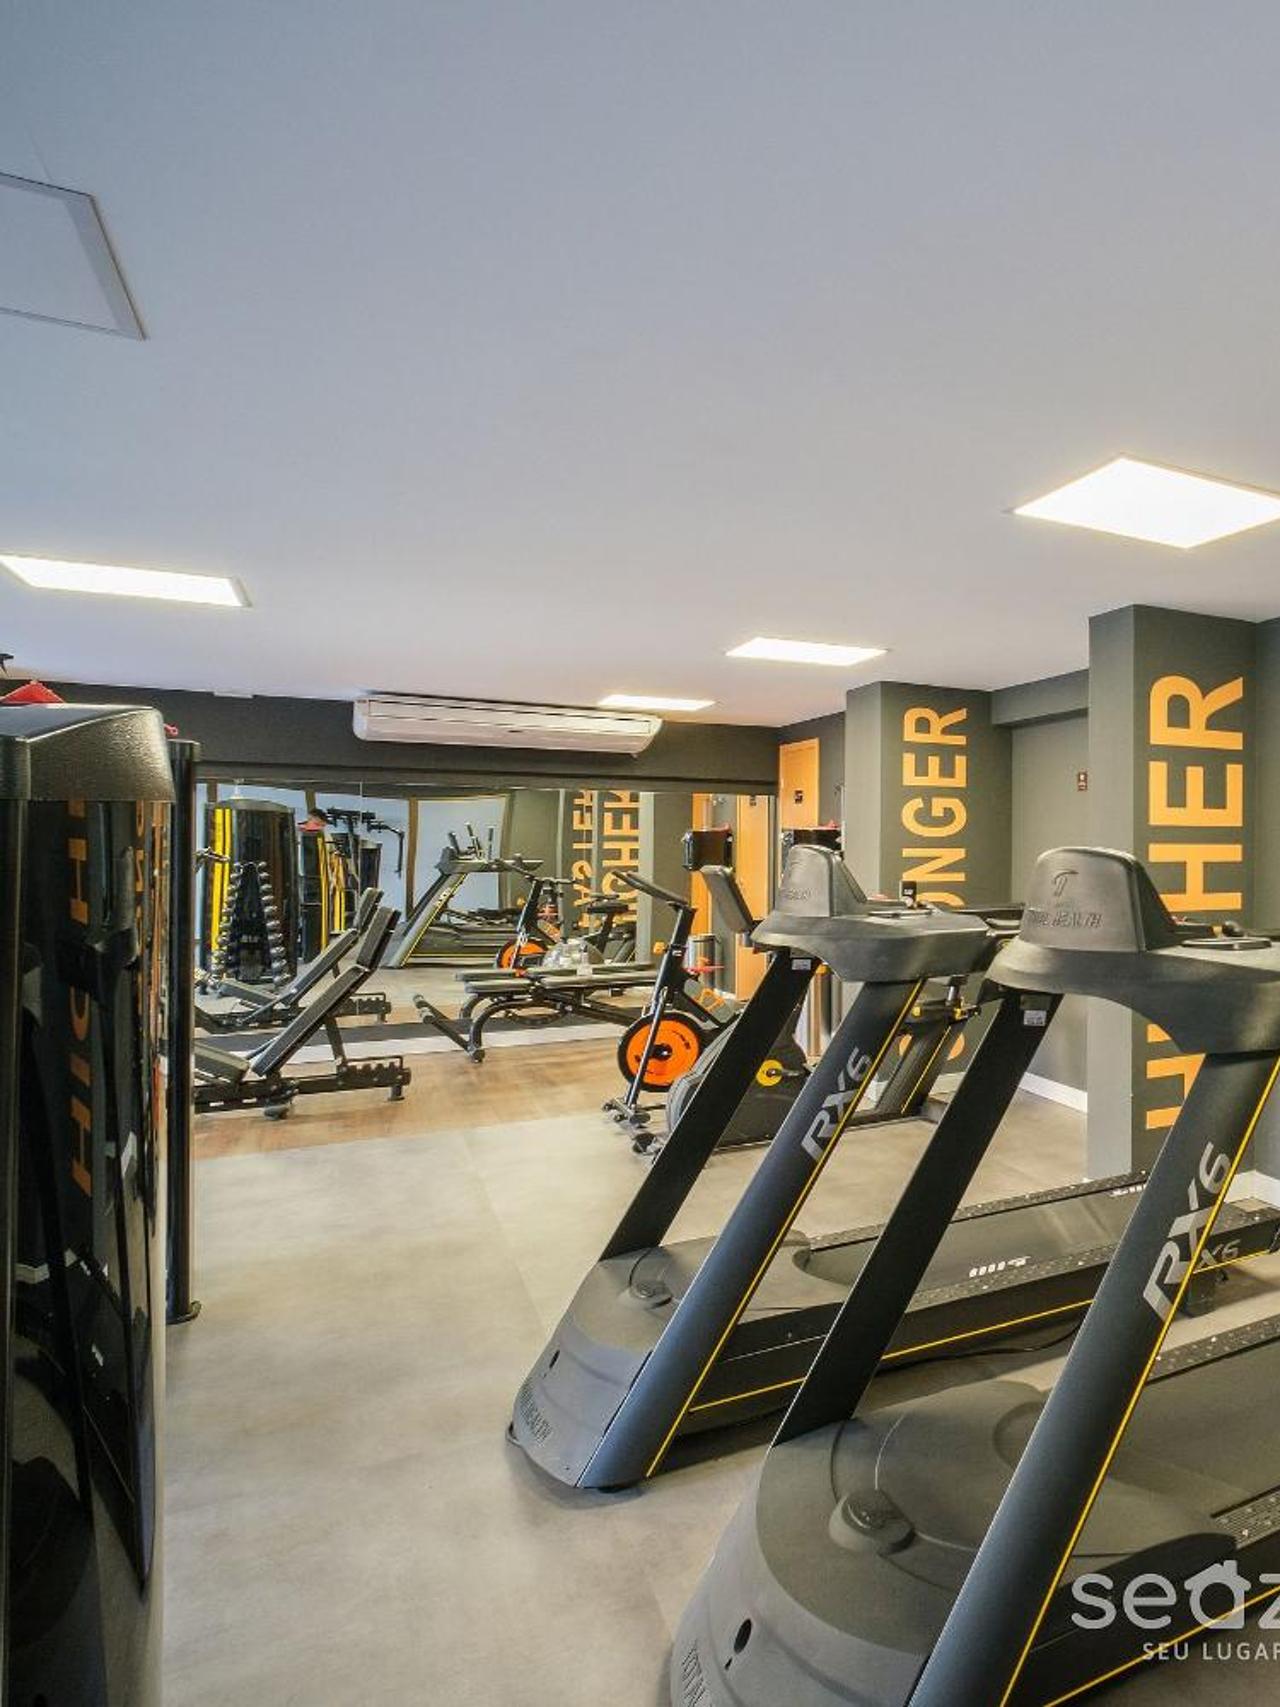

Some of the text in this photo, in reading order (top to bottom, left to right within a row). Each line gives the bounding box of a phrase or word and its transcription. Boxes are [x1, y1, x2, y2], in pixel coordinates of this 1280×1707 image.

[1146, 675, 1244, 1130] HER
[801, 1046, 873, 1163] RX6
[1143, 1141, 1231, 1321] RX6
